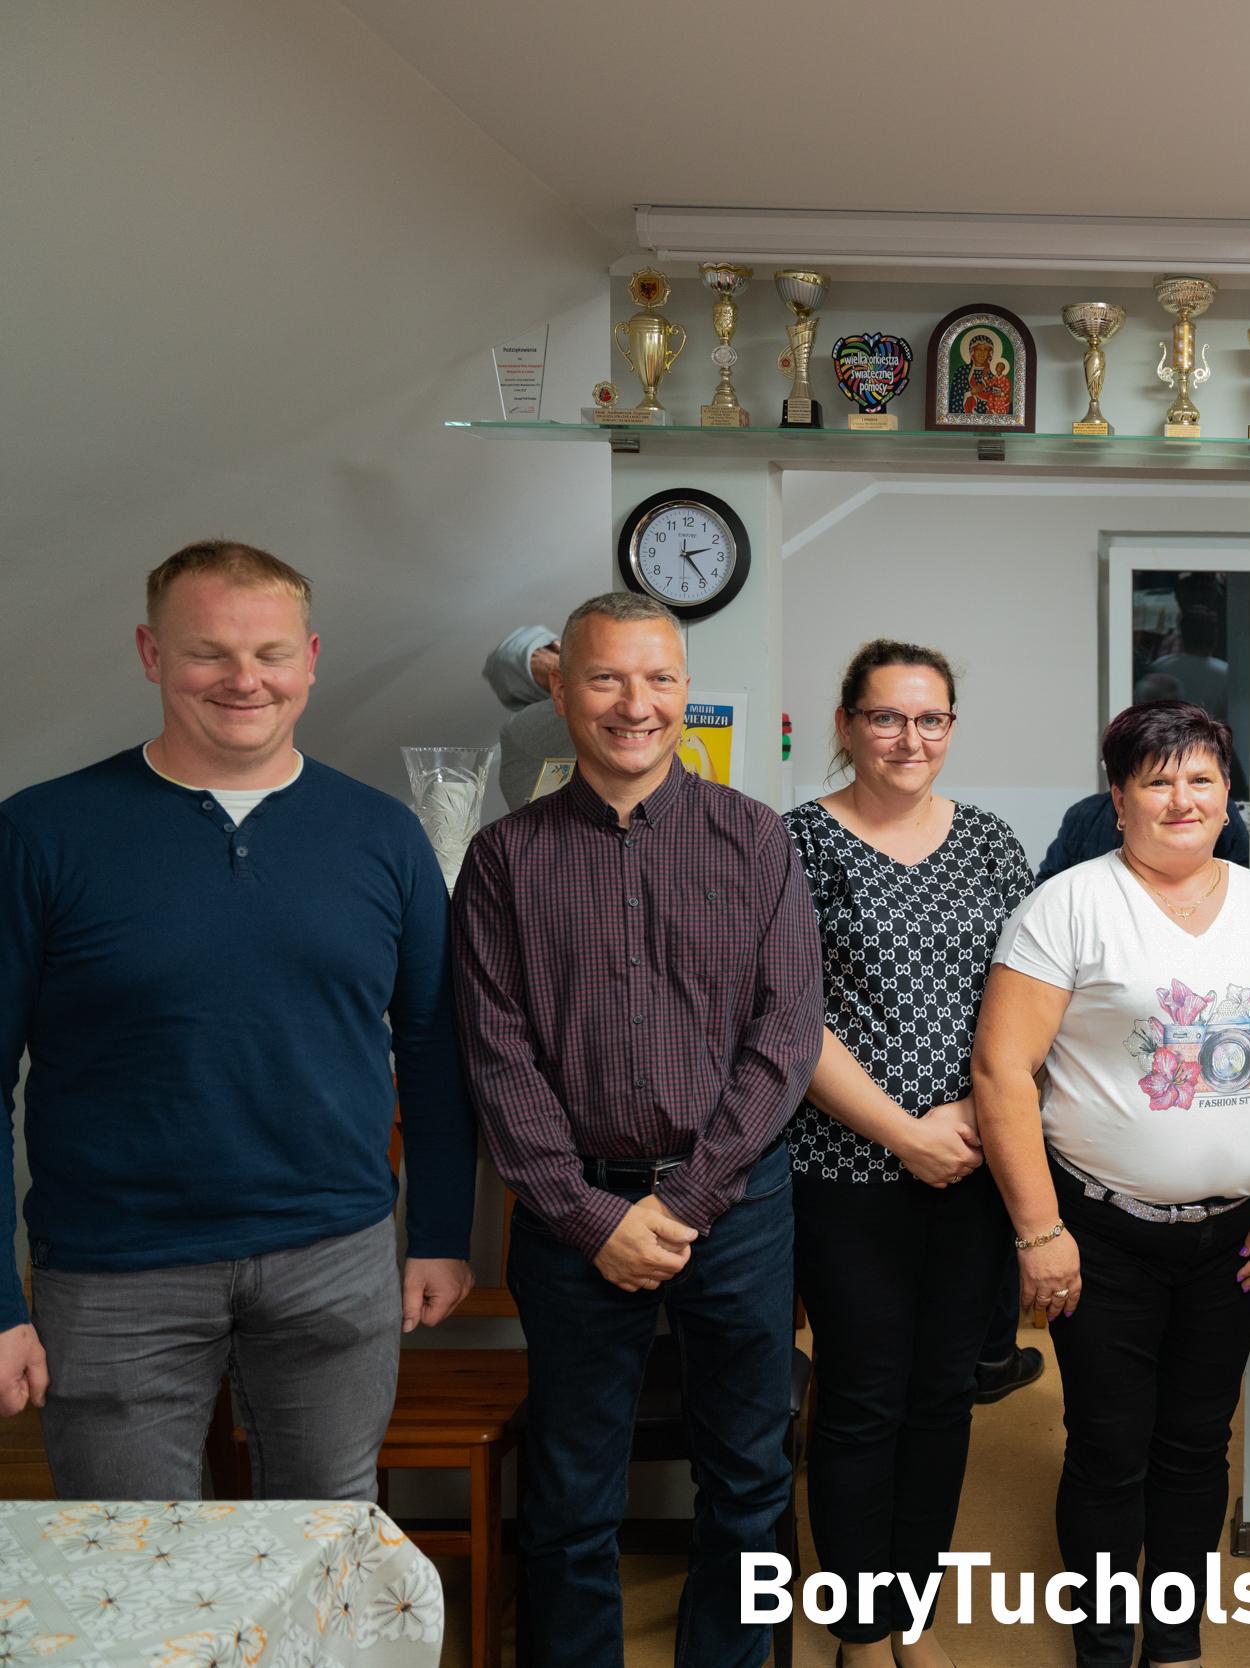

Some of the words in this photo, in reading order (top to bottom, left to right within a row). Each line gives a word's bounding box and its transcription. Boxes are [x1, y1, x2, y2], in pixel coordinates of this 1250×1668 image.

[844, 351, 868, 365] wielka
[869, 352, 899, 366] orkiestra
[860, 383, 887, 395] pomocy
[667, 521, 676, 531] 11
[683, 517, 694, 527] 12
[702, 522, 706, 532] 1
[654, 532, 666, 542] 10
[712, 534, 720, 544] 2
[648, 547, 656, 558] 9
[717, 552, 724, 562] 3
[653, 565, 661, 575] 8
[711, 568, 718, 578] 4
[666, 577, 673, 586] 7
[699, 579, 706, 588] 5
[681, 582, 688, 592] 6
[690, 705, 714, 714] MOJA
[1199, 1098, 1237, 1108] FASHION
